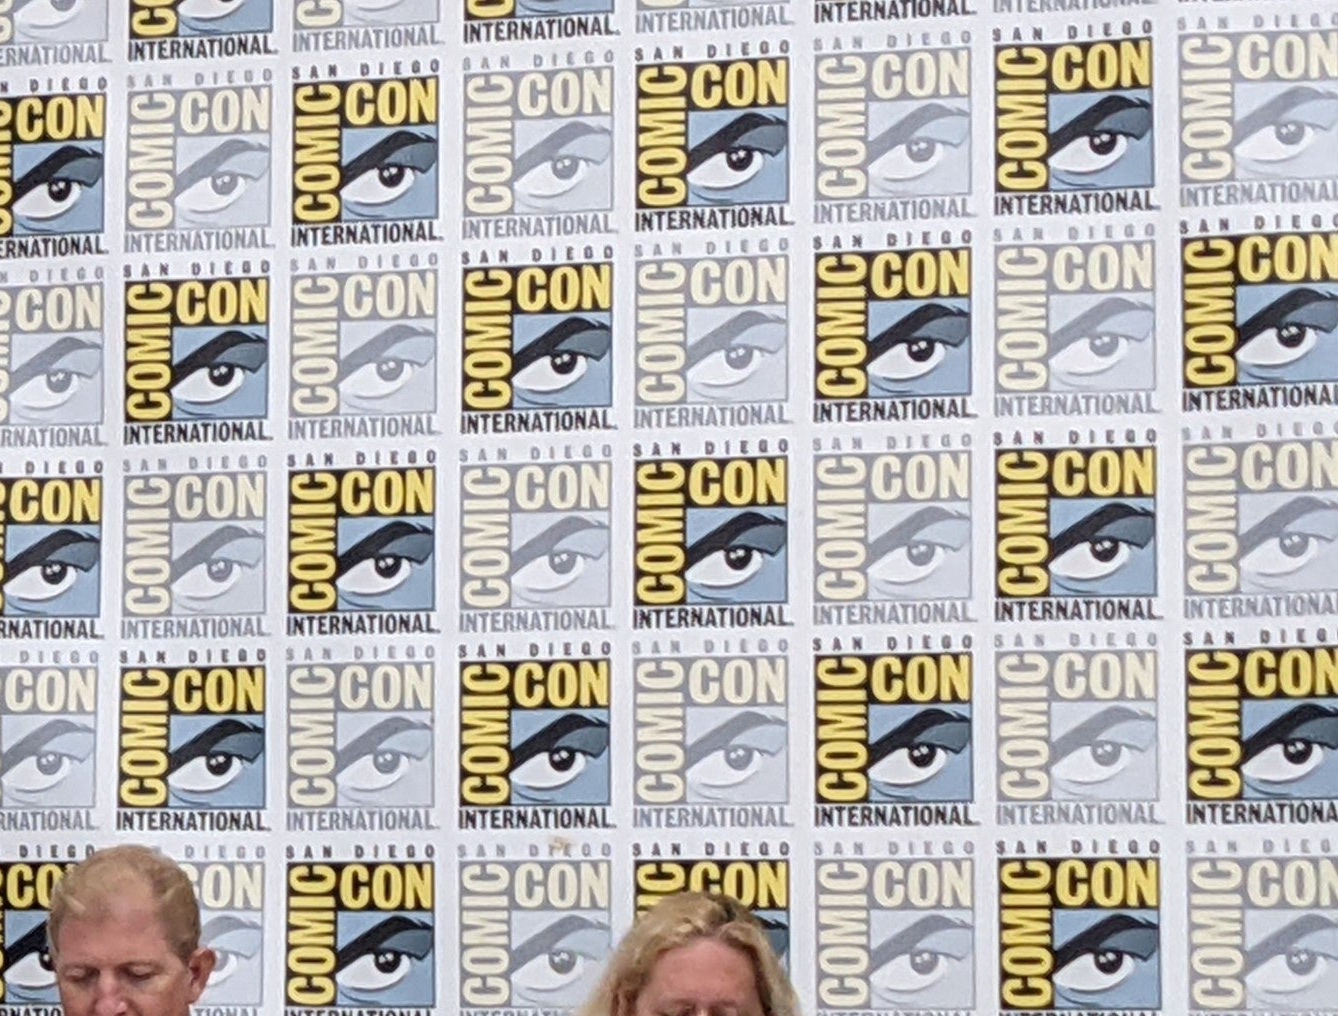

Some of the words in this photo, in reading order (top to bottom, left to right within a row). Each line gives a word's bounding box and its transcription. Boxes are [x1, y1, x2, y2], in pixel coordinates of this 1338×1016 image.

[636, 47, 682, 61] SAN
[708, 42, 788, 57] DIEGO
[995, 29, 1041, 41] SAN
[1069, 21, 1151, 38] DIEGO
[31, 79, 105, 92] DIEGO
[695, 64, 788, 109] CON
[1056, 45, 1152, 91] CON
[18, 99, 105, 141] CON
[637, 67, 688, 206] COMIC
[996, 50, 1049, 190] COMIC
[636, 207, 792, 231] INTERNATIONAL
[995, 191, 1158, 214] INTERNATIONAL
[815, 236, 861, 249] SAN
[888, 233, 970, 245] DIEGO
[873, 255, 970, 298] CON
[814, 257, 867, 397] COMIC
[814, 399, 974, 421] INTERNATIONAL
[289, 454, 332, 466] SAN
[357, 451, 435, 464] DIEGO
[995, 433, 1042, 445] SAN
[1070, 432, 1156, 444] DIEGO
[341, 472, 434, 515] CON
[1052, 451, 1156, 497] CON
[287, 471, 337, 611] COMIC
[995, 452, 1050, 596] COMIC
[287, 614, 439, 635] INTERNATIONAL
[995, 600, 1160, 620] INTERNATIONAL
[814, 639, 861, 651] SAN
[888, 637, 971, 650] DIEGO
[871, 656, 972, 702] CON
[814, 656, 869, 801] COMIC
[815, 806, 977, 826] INTERNATIONAL
[997, 842, 1046, 854] SAN
[1073, 841, 1159, 853] DIEGO
[1056, 862, 1159, 907] CON
[998, 859, 1054, 1007] COMIC
